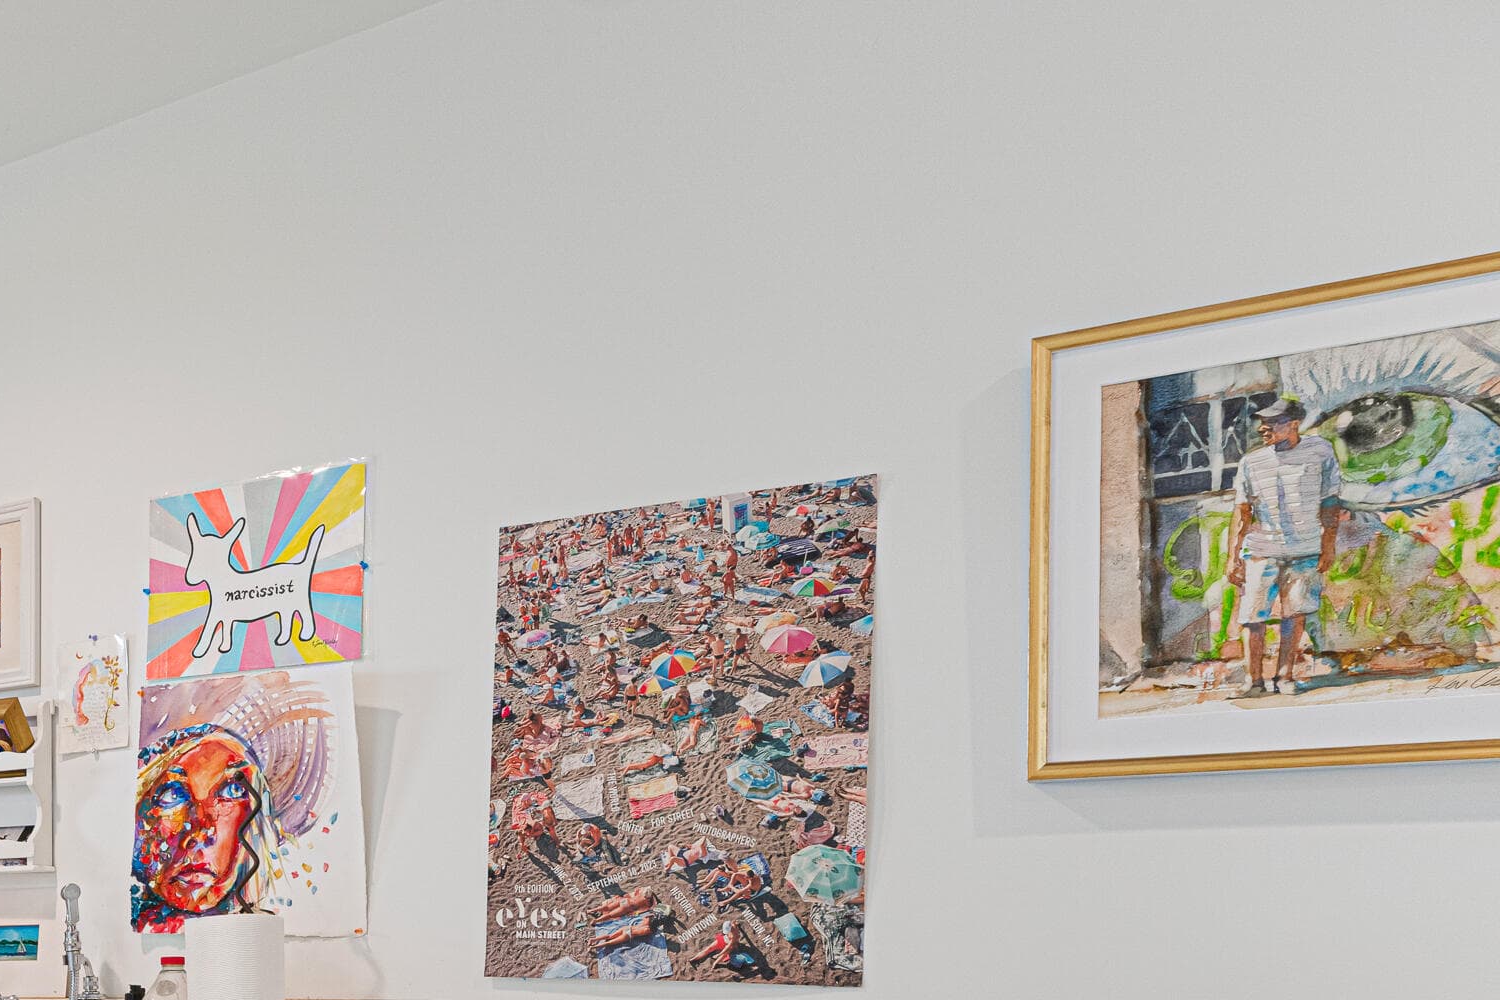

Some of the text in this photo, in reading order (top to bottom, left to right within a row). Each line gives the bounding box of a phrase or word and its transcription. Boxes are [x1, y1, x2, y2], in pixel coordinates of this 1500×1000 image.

[225, 580, 294, 601] narcissist
[651, 808, 695, 828] FOR STREET
[617, 820, 645, 836] CENTER
[693, 822, 756, 848] PHOTOGRAPHERS
[551, 864, 568, 881] JUNE
[586, 871, 628, 892] SEPTEMBER
[640, 860, 658, 873] 2023
[515, 884, 554, 894] 9th EDITION
[670, 886, 696, 917] HISTORIC
[516, 920, 527, 929] ON
[677, 912, 718, 944] DOWNTOWN
[516, 930, 566, 939] MAIN STREET
[761, 934, 775, 947] NC
